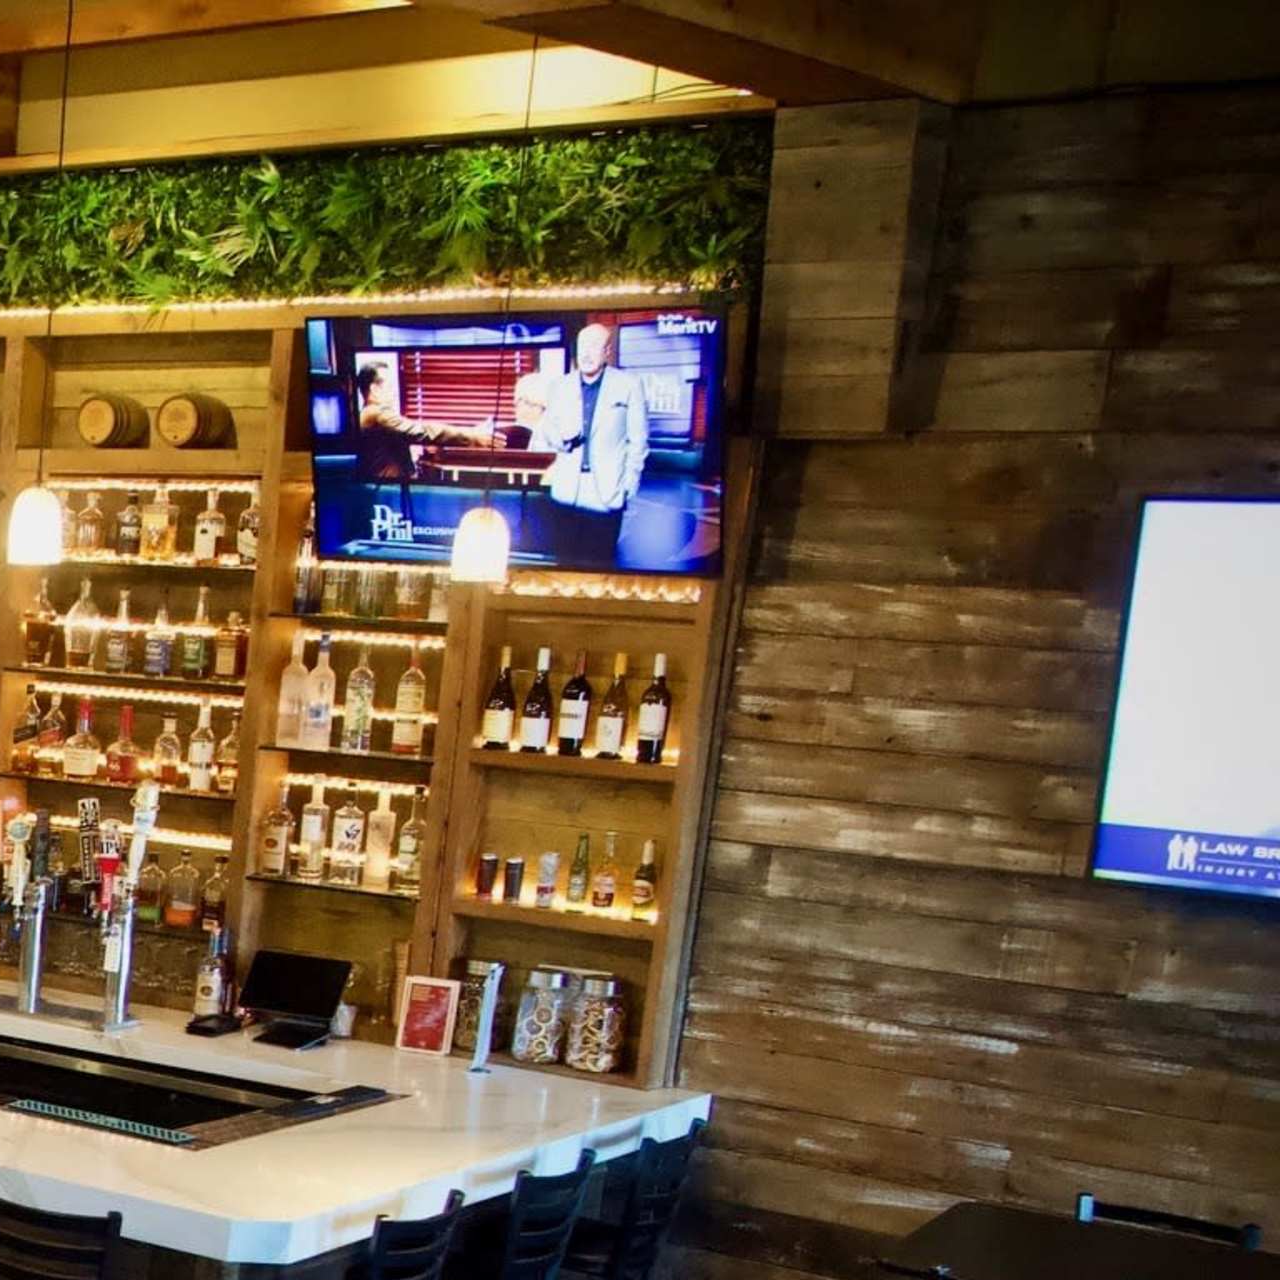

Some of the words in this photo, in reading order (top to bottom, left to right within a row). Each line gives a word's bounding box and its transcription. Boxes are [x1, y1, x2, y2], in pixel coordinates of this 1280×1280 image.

[371, 519, 414, 541] Phil
[1200, 841, 1249, 857] LAW
[1197, 864, 1258, 877] INJURY
